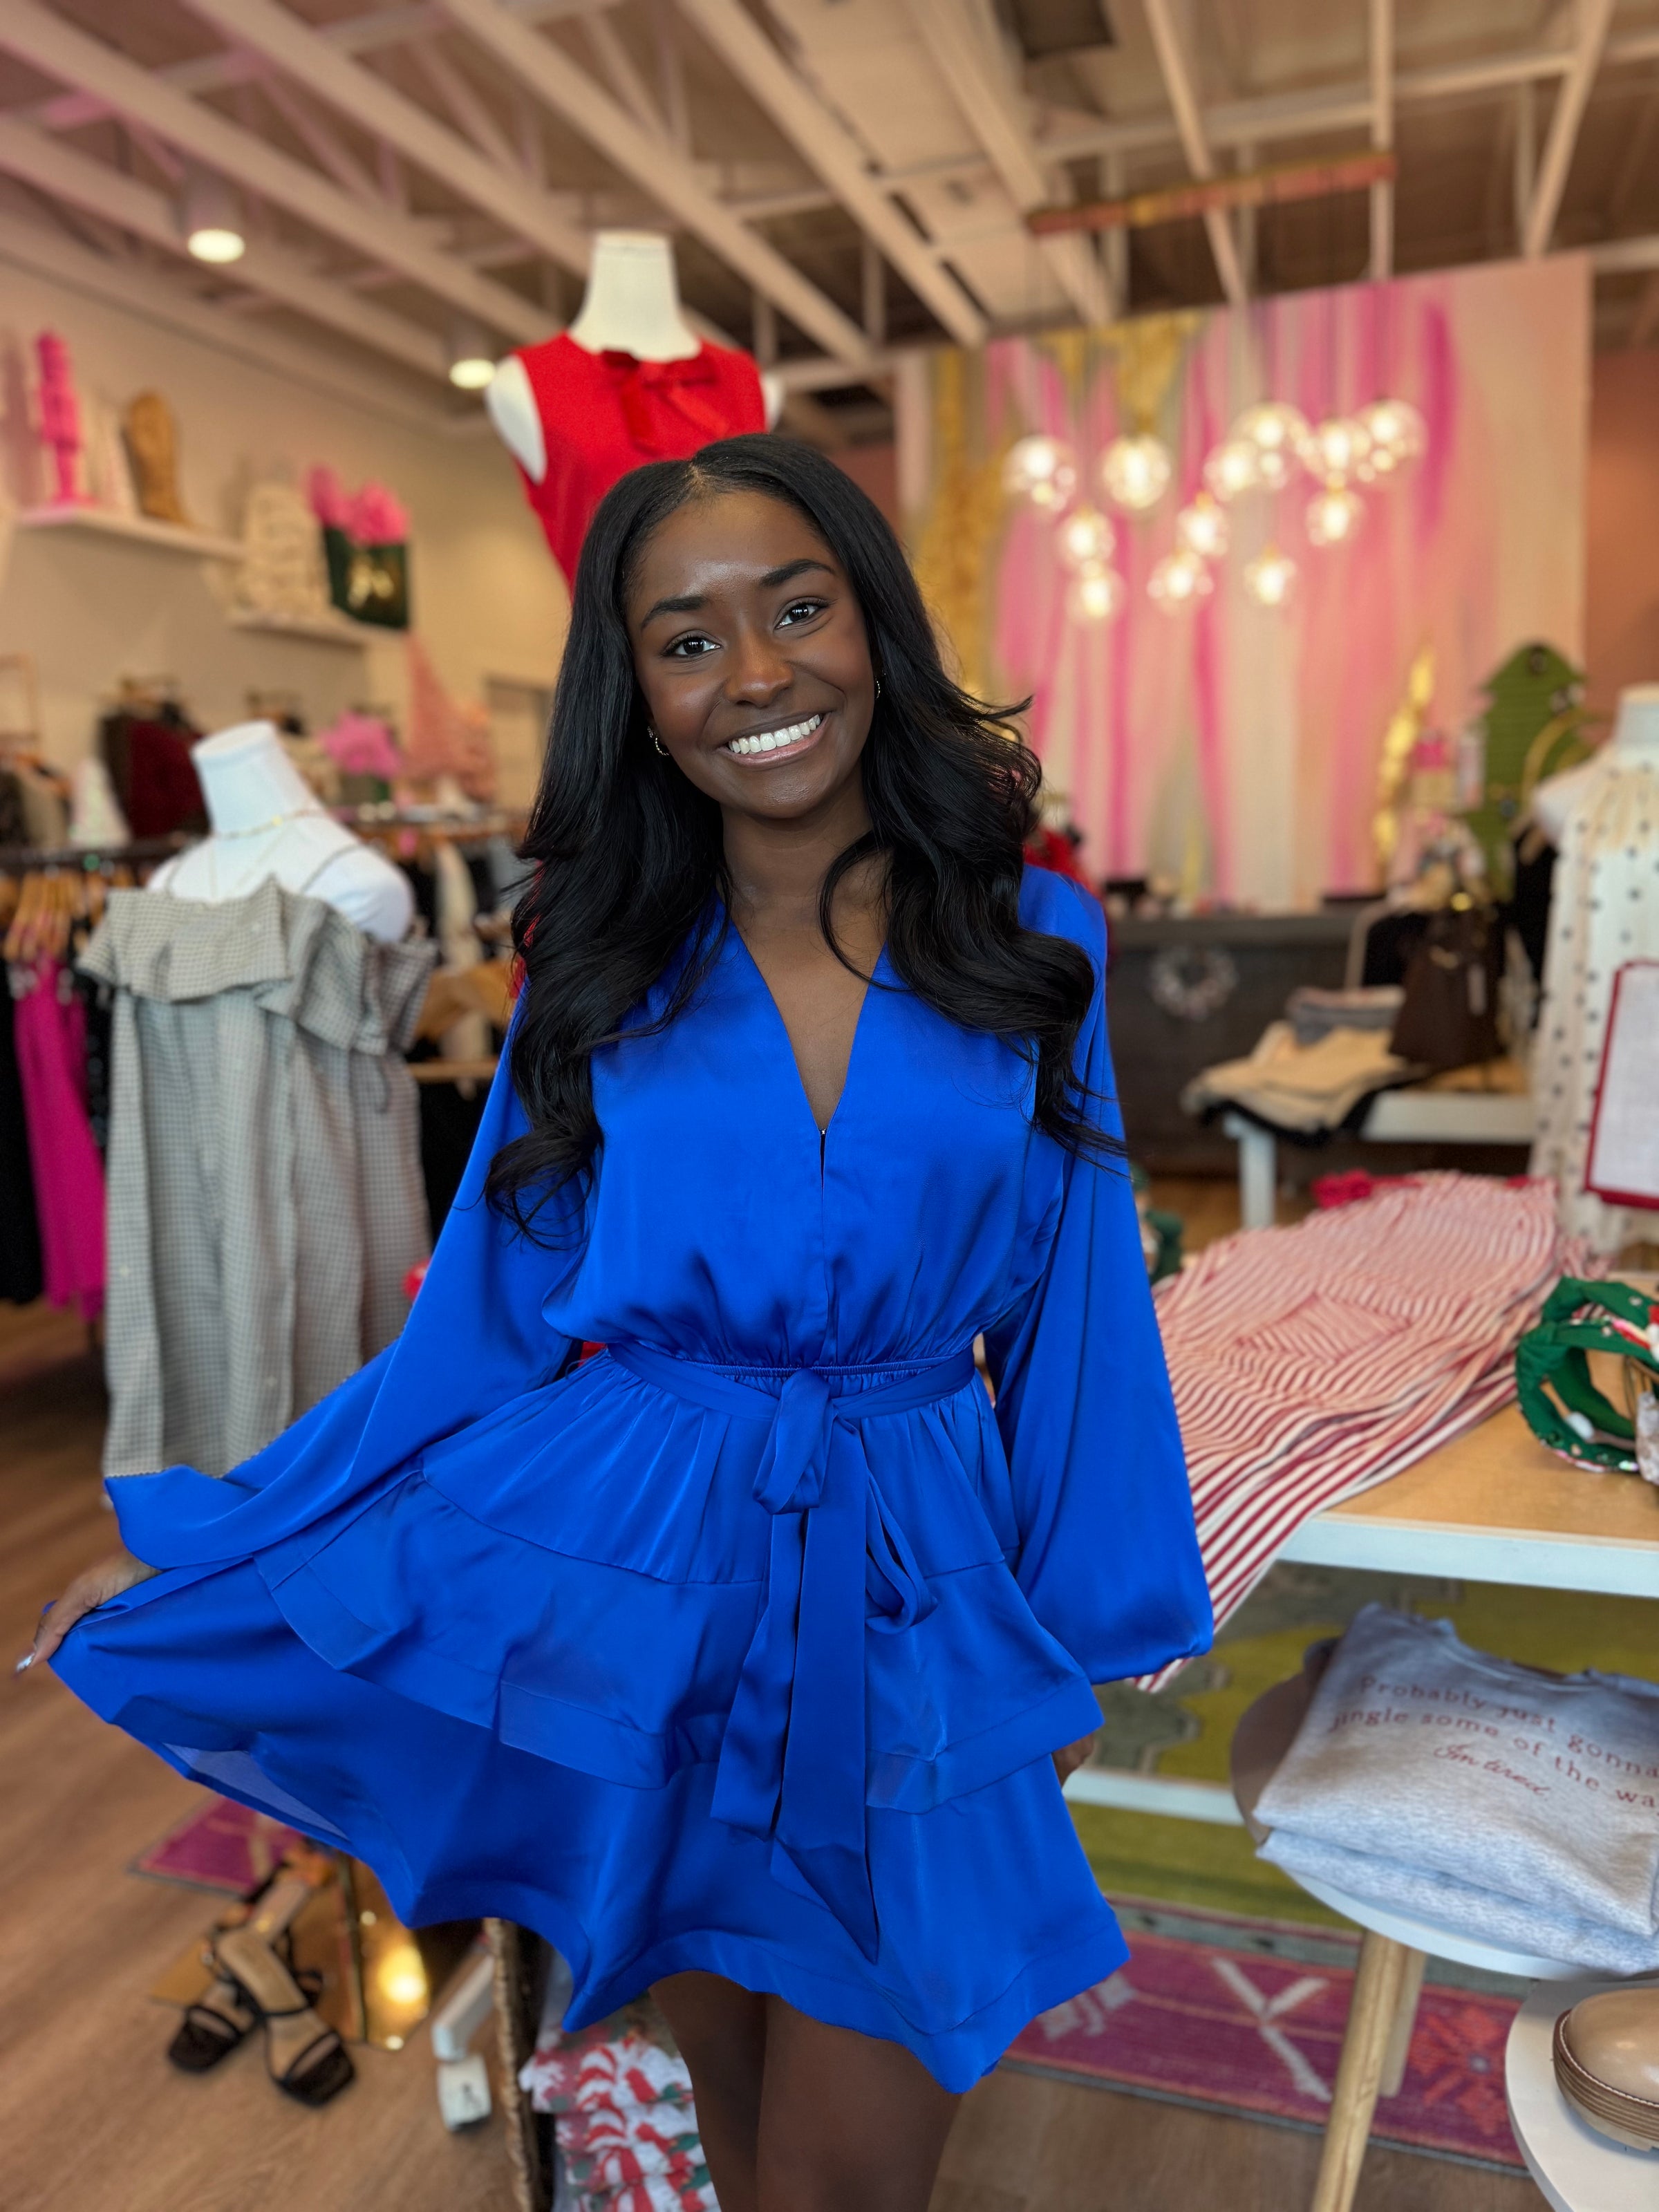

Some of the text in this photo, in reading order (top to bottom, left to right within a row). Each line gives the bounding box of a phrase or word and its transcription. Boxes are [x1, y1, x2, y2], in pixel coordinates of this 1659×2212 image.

[1329, 1706, 1659, 1817] jingle some of the wa
[1361, 1675, 1659, 1779] Probably just gonna
